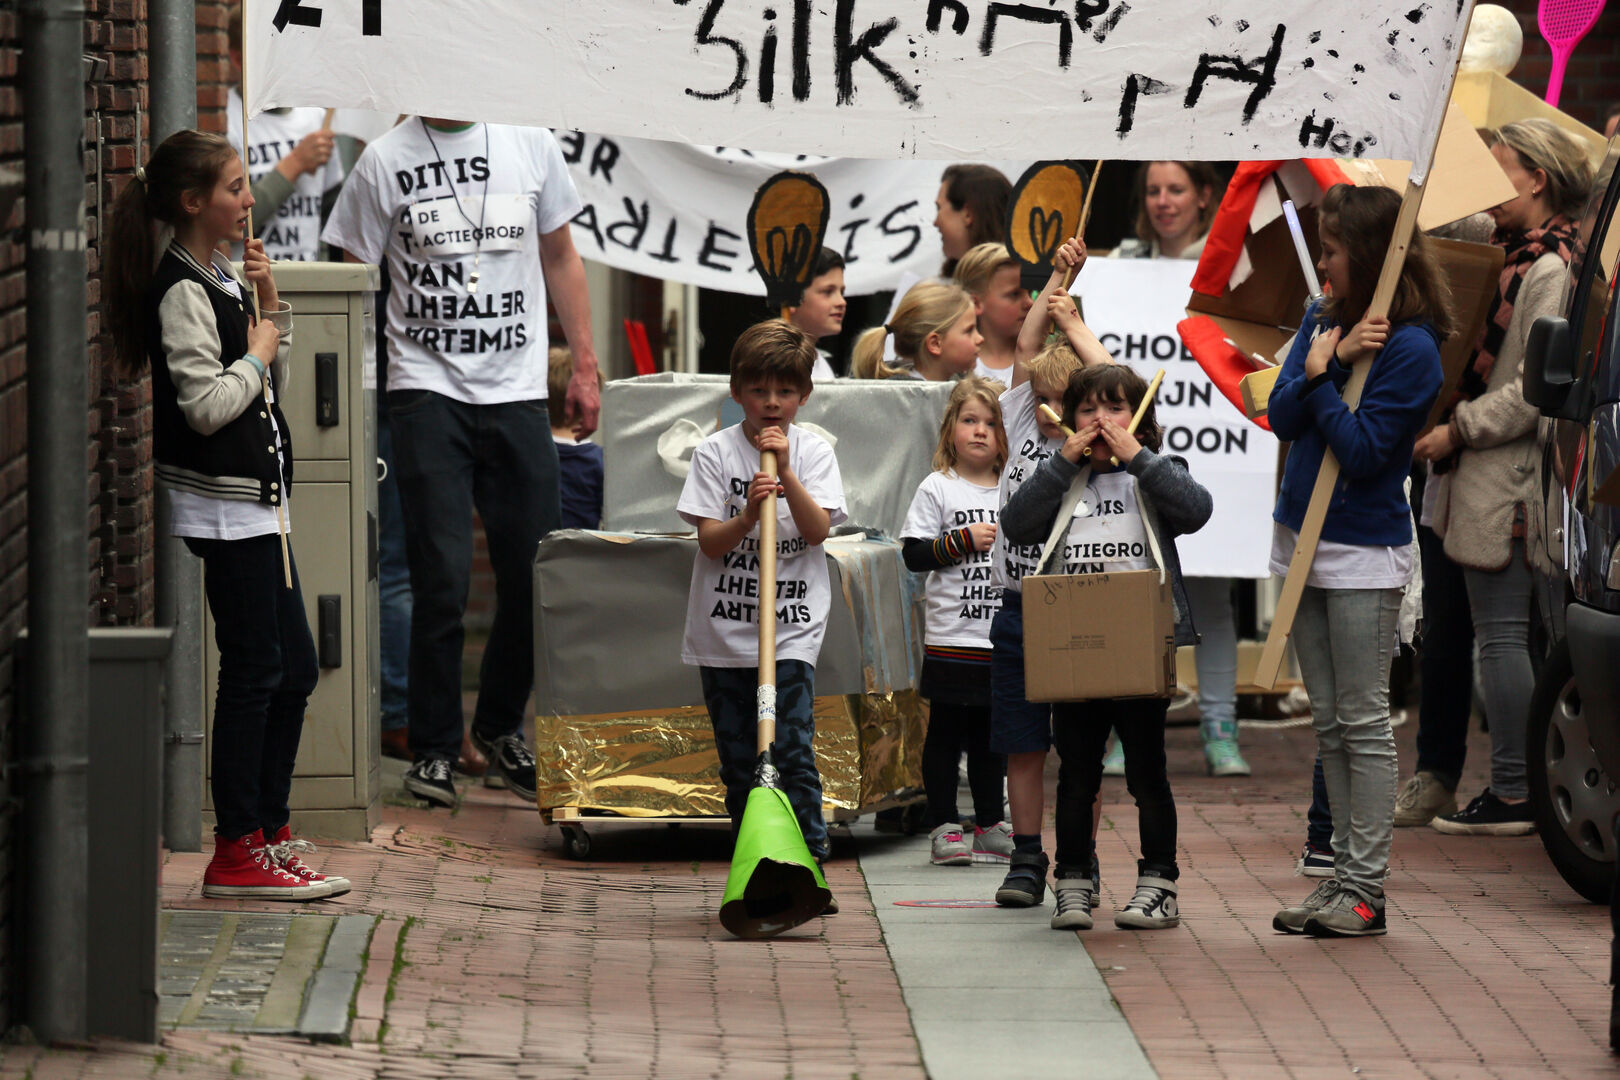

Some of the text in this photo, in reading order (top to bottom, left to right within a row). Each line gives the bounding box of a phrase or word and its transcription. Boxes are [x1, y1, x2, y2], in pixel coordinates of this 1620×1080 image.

[396, 156, 491, 196] DIT IS
[418, 210, 440, 225] DE
[423, 226, 525, 248] ACTIEGROEP
[403, 262, 463, 287] VAN
[404, 290, 526, 319] THEATER
[405, 323, 528, 353] ARTEMIS
[1160, 426, 1248, 454] OON
[1009, 467, 1024, 482] DE
[955, 509, 985, 525] DIT
[714, 574, 807, 600] THETER
[710, 600, 811, 624] ARTMIS
